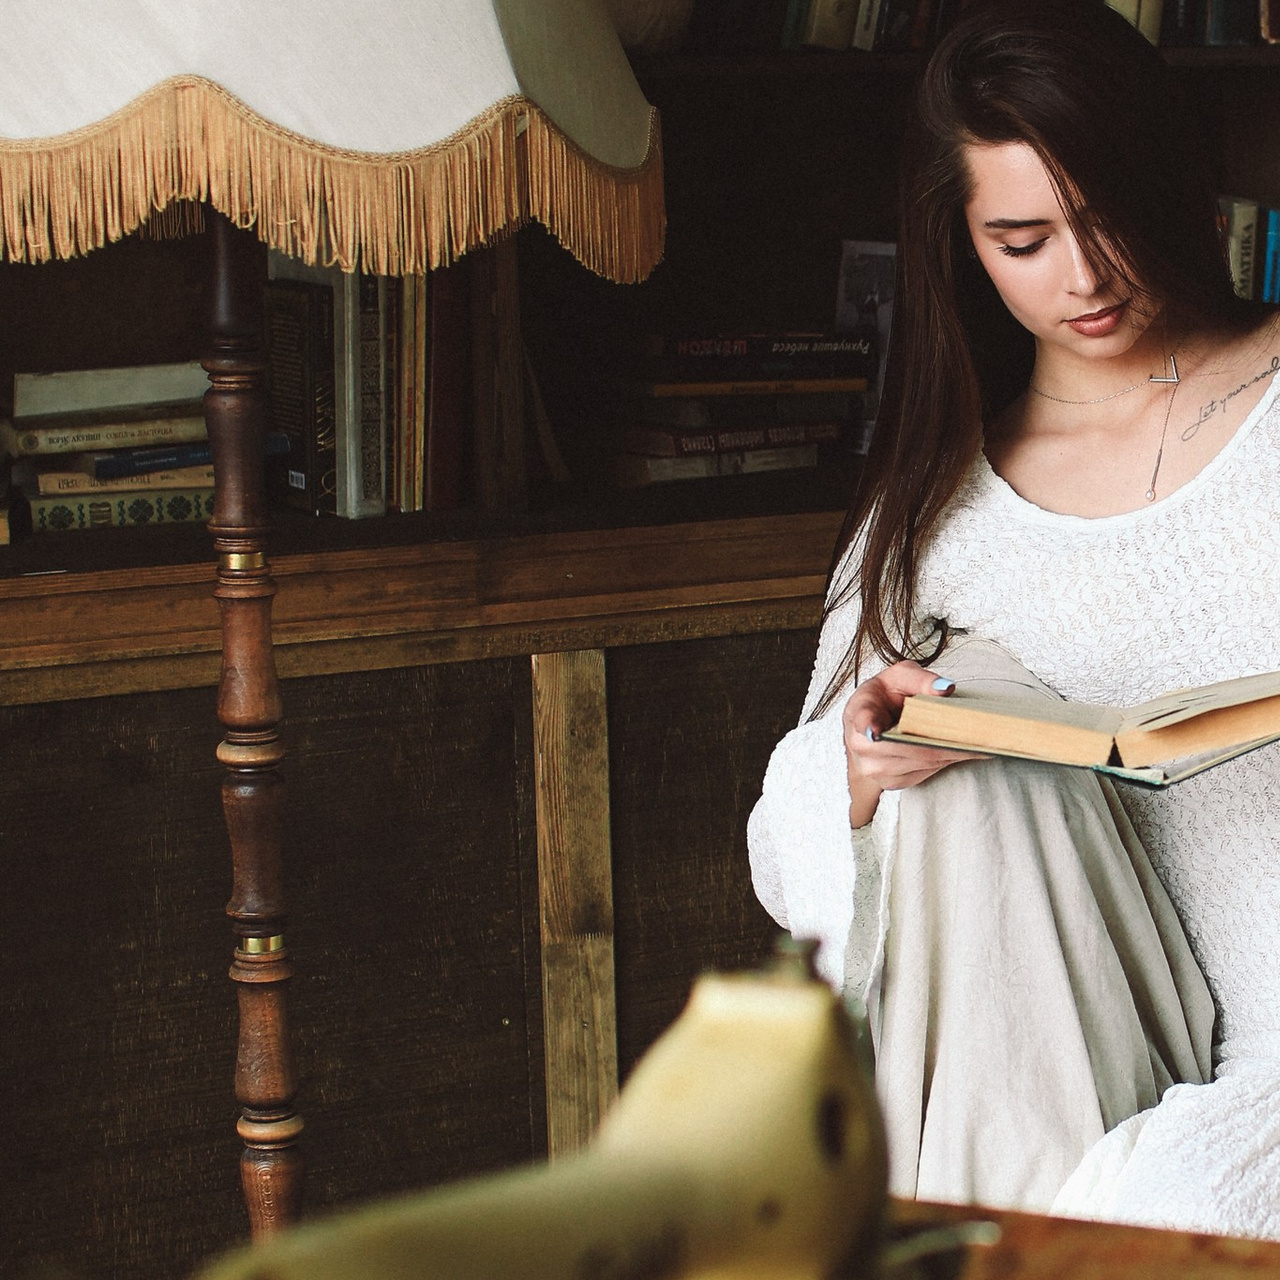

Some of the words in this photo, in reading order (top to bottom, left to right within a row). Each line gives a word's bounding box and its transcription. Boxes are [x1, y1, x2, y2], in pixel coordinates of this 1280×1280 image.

[771, 341, 809, 357] небеса
[812, 339, 870, 356] Рухнувшие
[1181, 400, 1217, 442] Let
[1220, 382, 1248, 413] your
